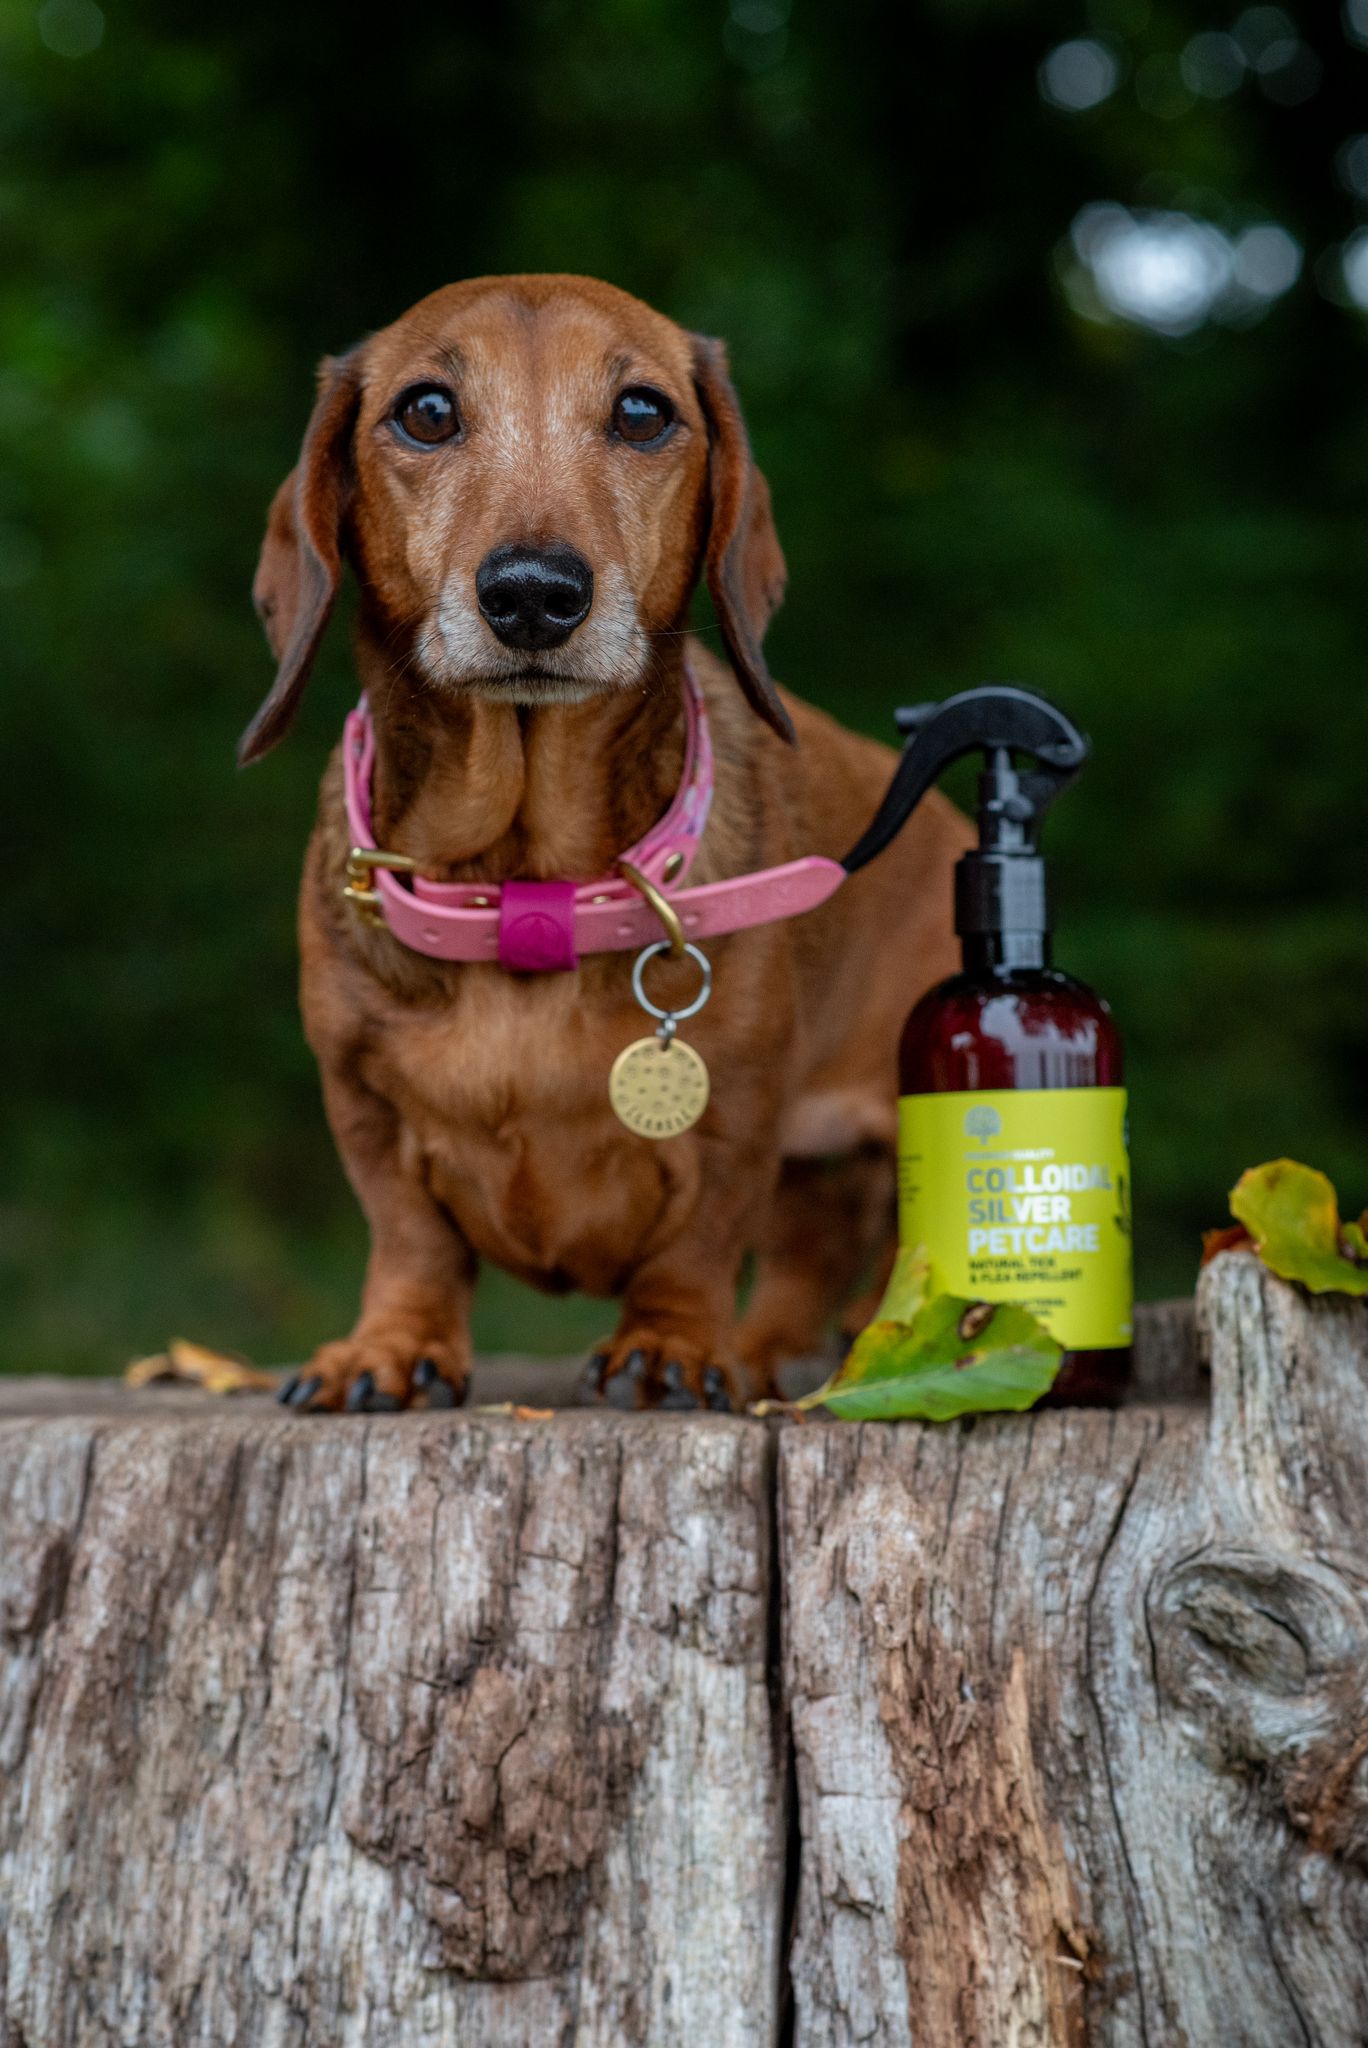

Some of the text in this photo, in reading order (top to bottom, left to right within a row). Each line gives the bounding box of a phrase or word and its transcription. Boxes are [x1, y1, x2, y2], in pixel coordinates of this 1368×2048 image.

[966, 1163, 1113, 1194] COLLOIDAL
[968, 1195, 1072, 1225] SILVER
[967, 1223, 1100, 1256] PETCARE
[969, 1258, 1025, 1270] NATURAL
[981, 1272, 1011, 1284] FLEA
[1016, 1267, 1082, 1283] REPELLENT
